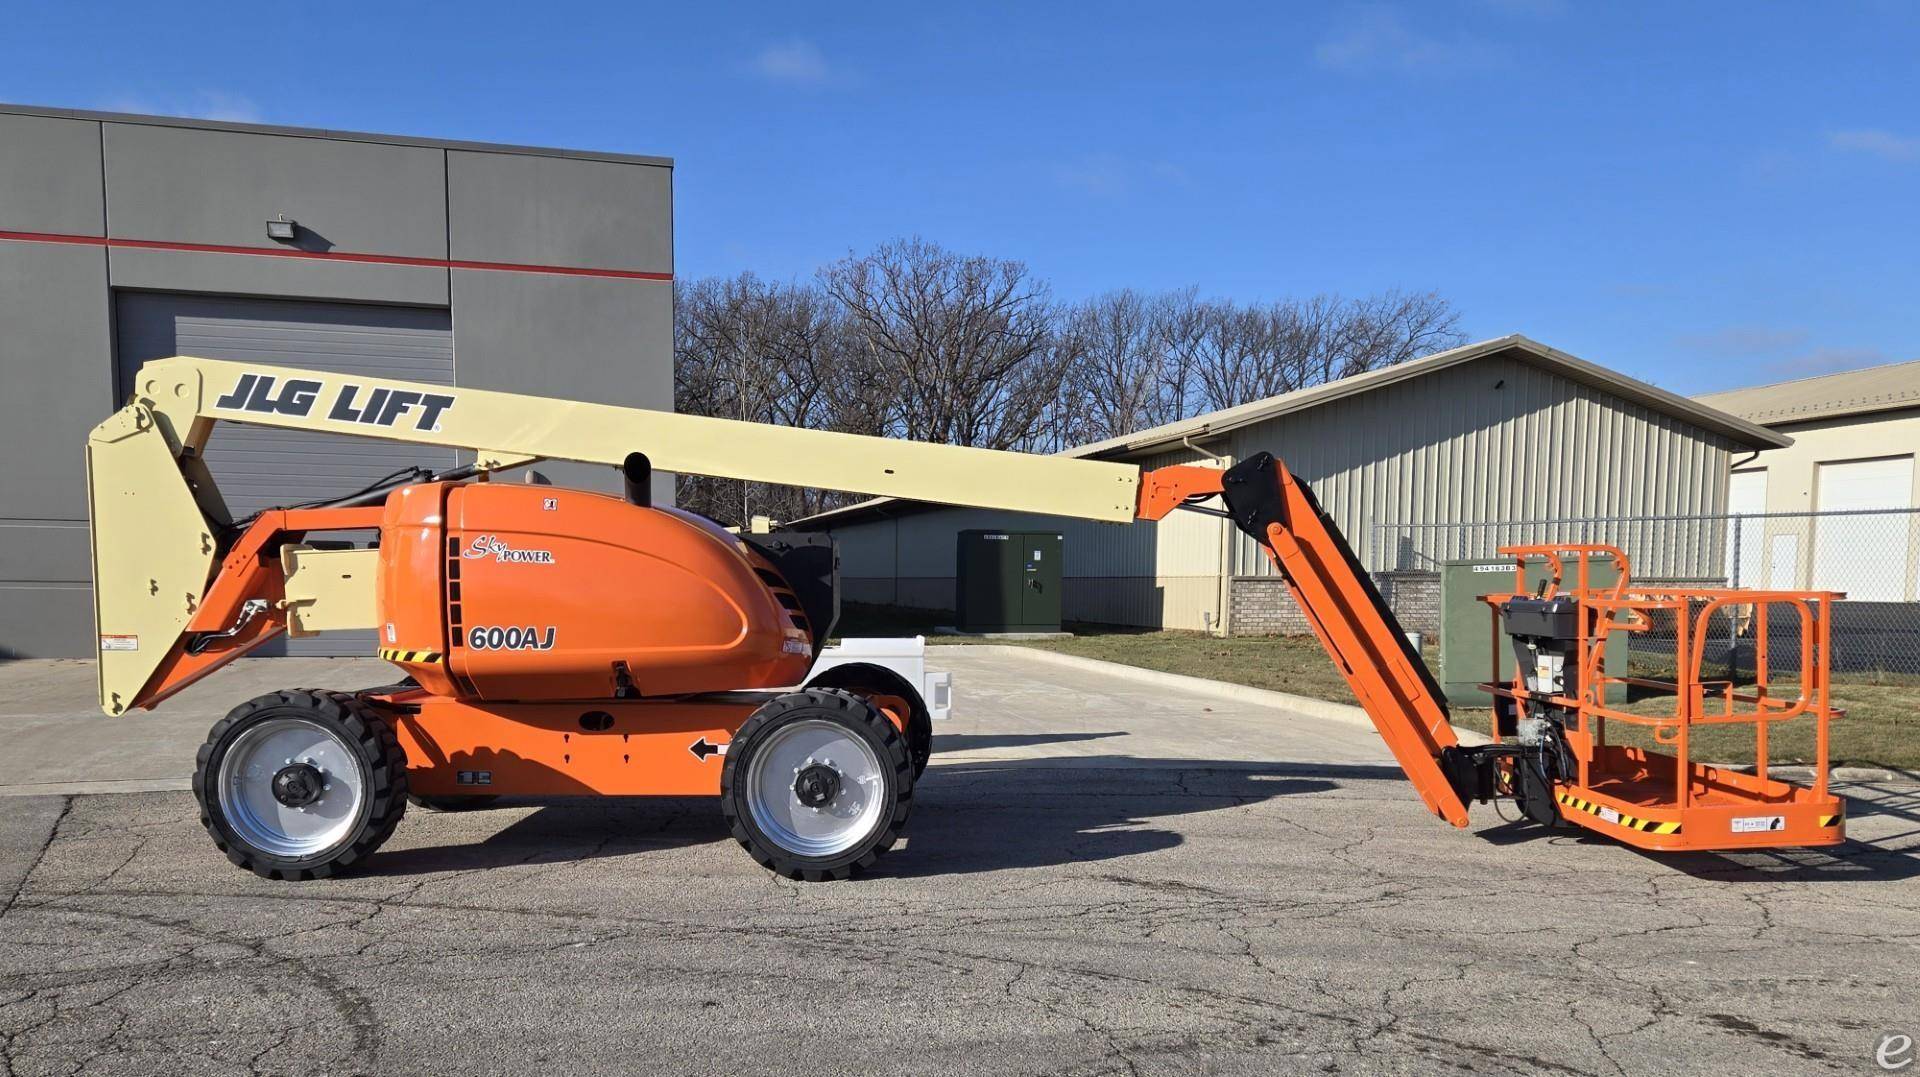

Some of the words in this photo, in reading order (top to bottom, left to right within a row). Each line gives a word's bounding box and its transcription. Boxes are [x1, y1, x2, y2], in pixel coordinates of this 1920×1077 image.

[215, 373, 323, 417] JLG
[327, 384, 456, 431] LIFT
[469, 627, 556, 650] 600AJ
